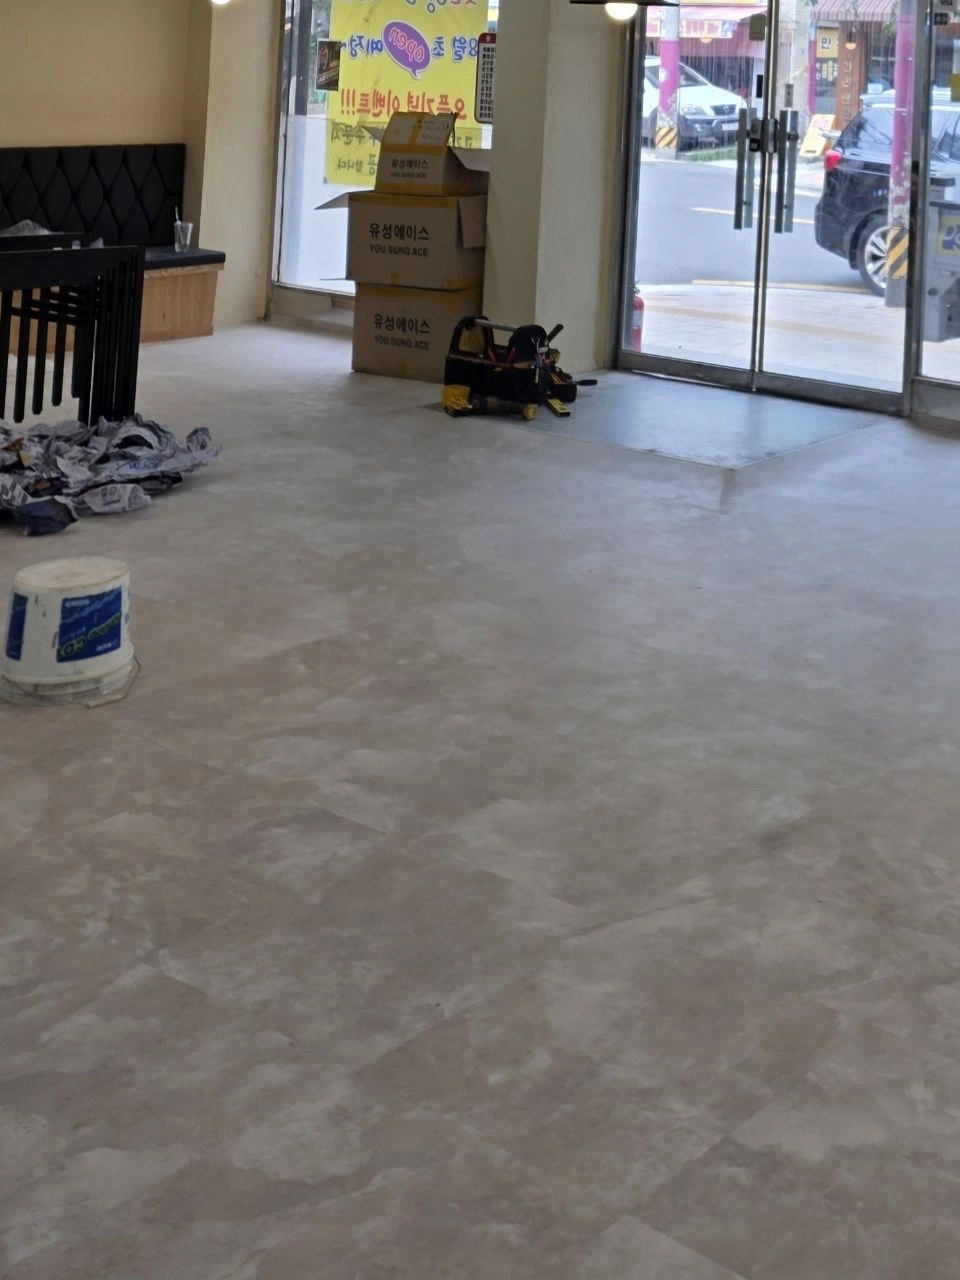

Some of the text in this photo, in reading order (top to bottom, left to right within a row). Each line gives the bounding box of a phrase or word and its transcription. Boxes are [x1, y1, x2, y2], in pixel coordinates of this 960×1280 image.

[369, 222, 430, 241] 유성에이스
[369, 243, 429, 258] YOU SUNG ACE
[373, 313, 431, 335] 유성에이스
[413, 340, 430, 351] ACE
